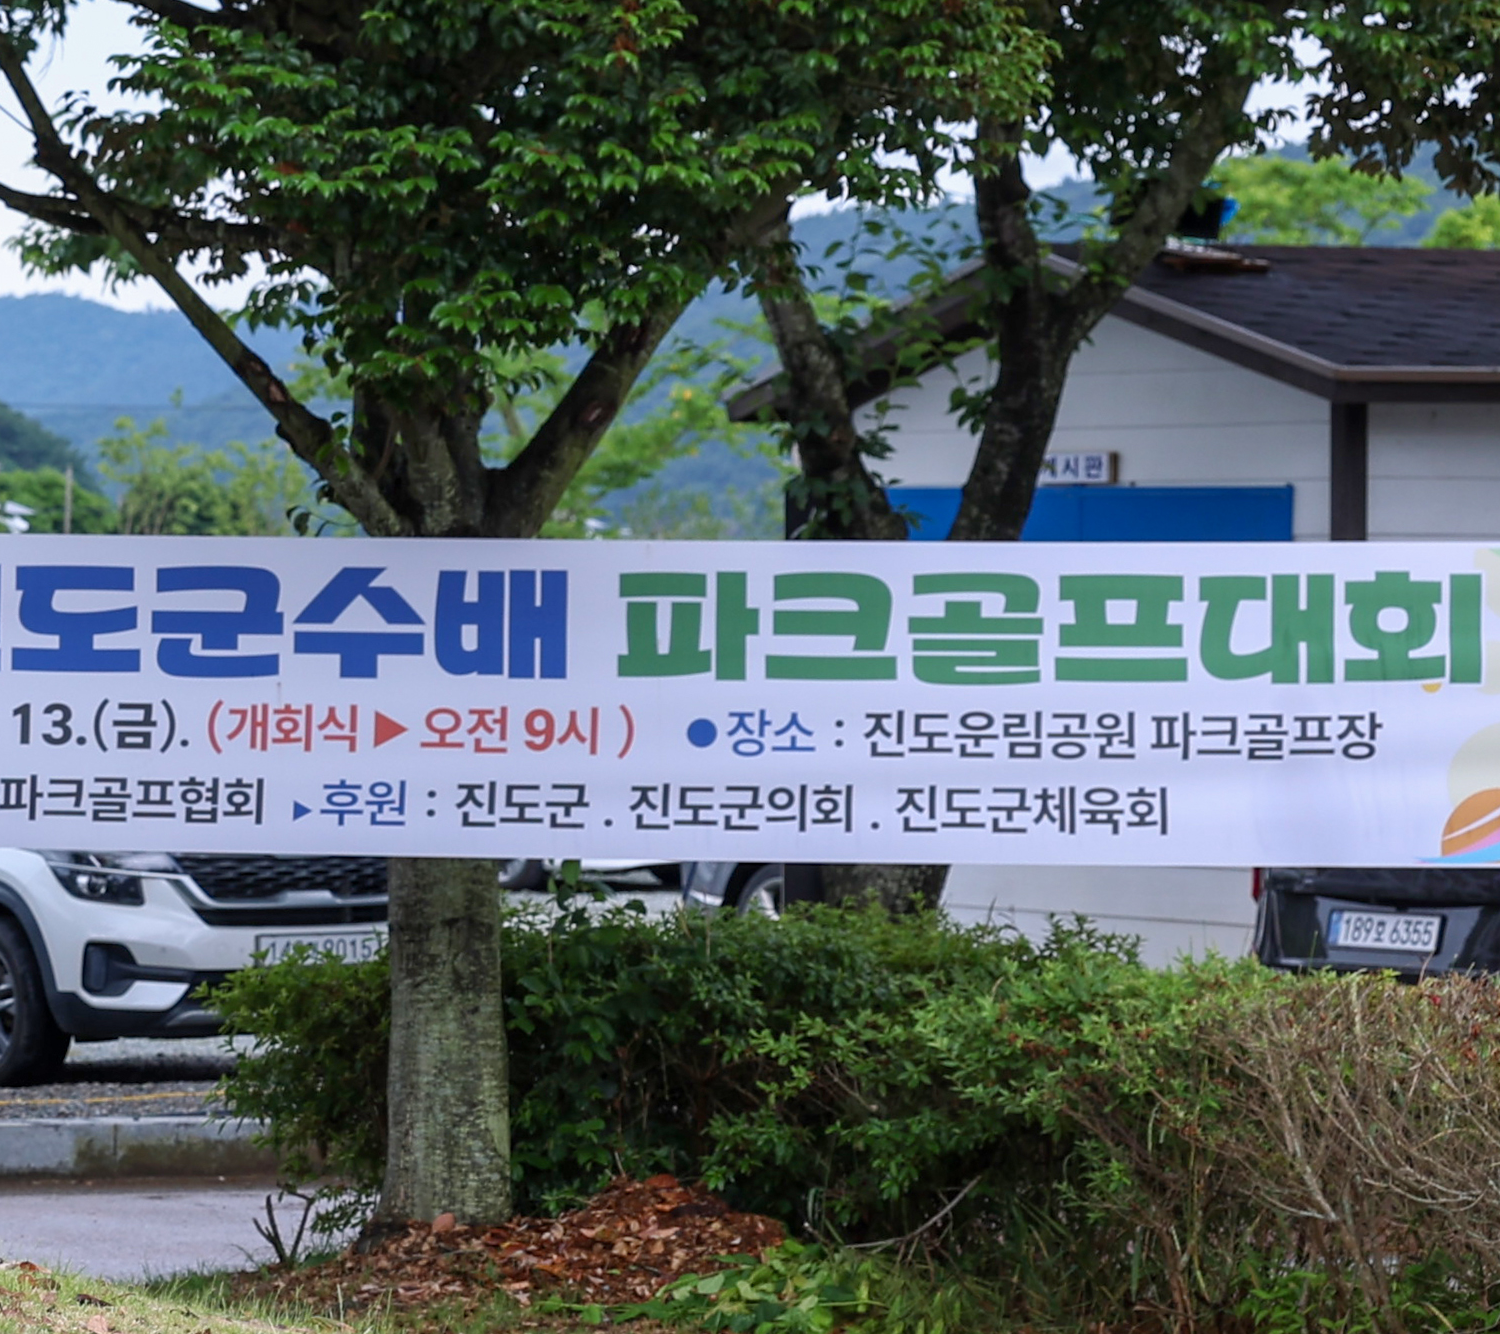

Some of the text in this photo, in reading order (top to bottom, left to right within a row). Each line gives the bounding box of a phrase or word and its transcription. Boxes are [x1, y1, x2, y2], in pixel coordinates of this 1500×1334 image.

[617, 571, 1482, 685] 파크골프대회
[207, 699, 359, 754] (개회식
[419, 706, 509, 754] 오전
[523, 706, 600, 756] 9시
[726, 709, 816, 757] 장소
[862, 710, 1136, 760] 진도운림공원
[1150, 710, 1383, 760] 파크골프장
[319, 779, 407, 827] 후원
[455, 781, 590, 829] 진도군
[629, 783, 854, 832] 진도군의회
[896, 784, 1170, 836] 진도군체육회
[1389, 919, 1435, 947] 6355
